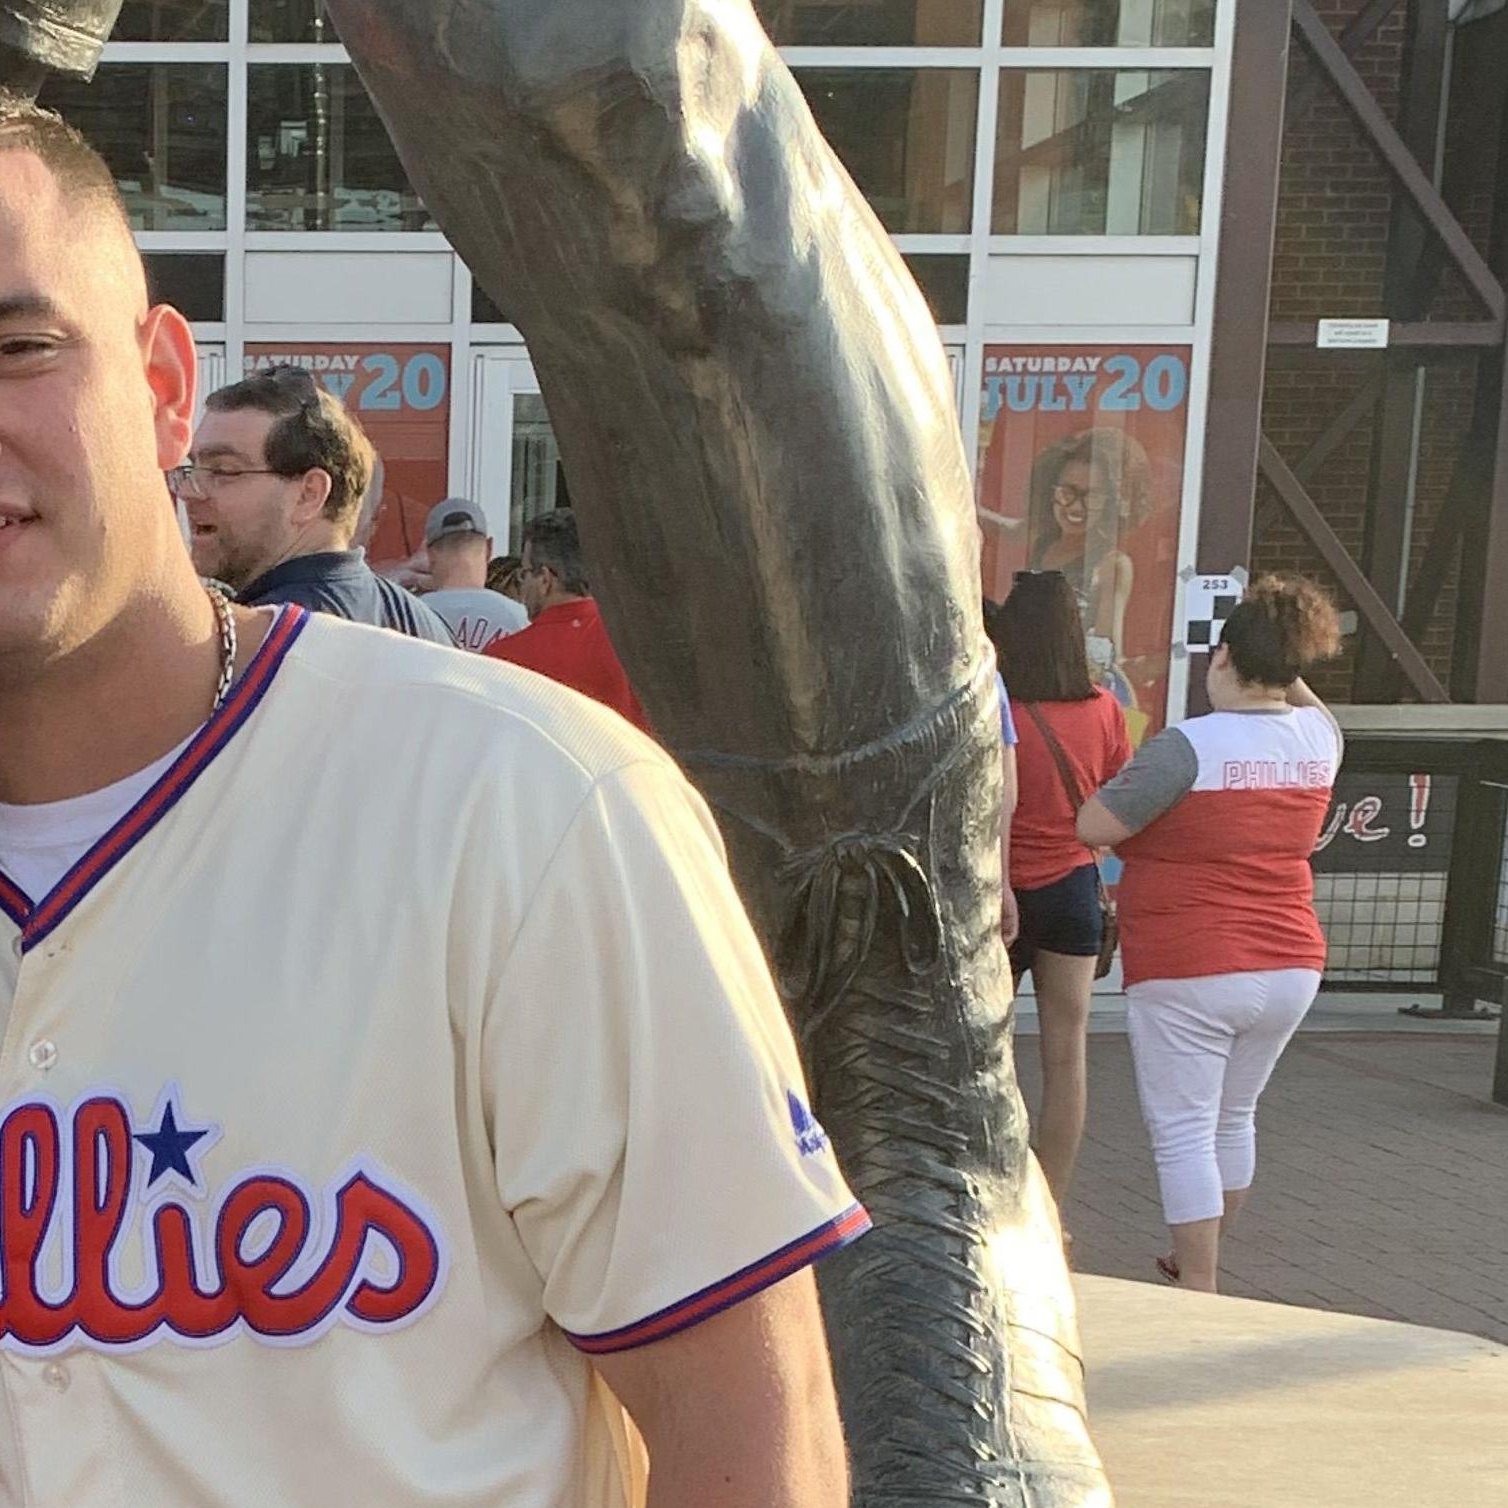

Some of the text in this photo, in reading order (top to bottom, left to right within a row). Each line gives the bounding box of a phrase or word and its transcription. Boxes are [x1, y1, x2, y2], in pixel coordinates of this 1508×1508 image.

[985, 356, 1102, 372] SATURDAY
[359, 353, 446, 411] 20
[981, 354, 1187, 421] JULY 20
[1202, 579, 1229, 590] 253
[1223, 760, 1331, 790] PHILLIES
